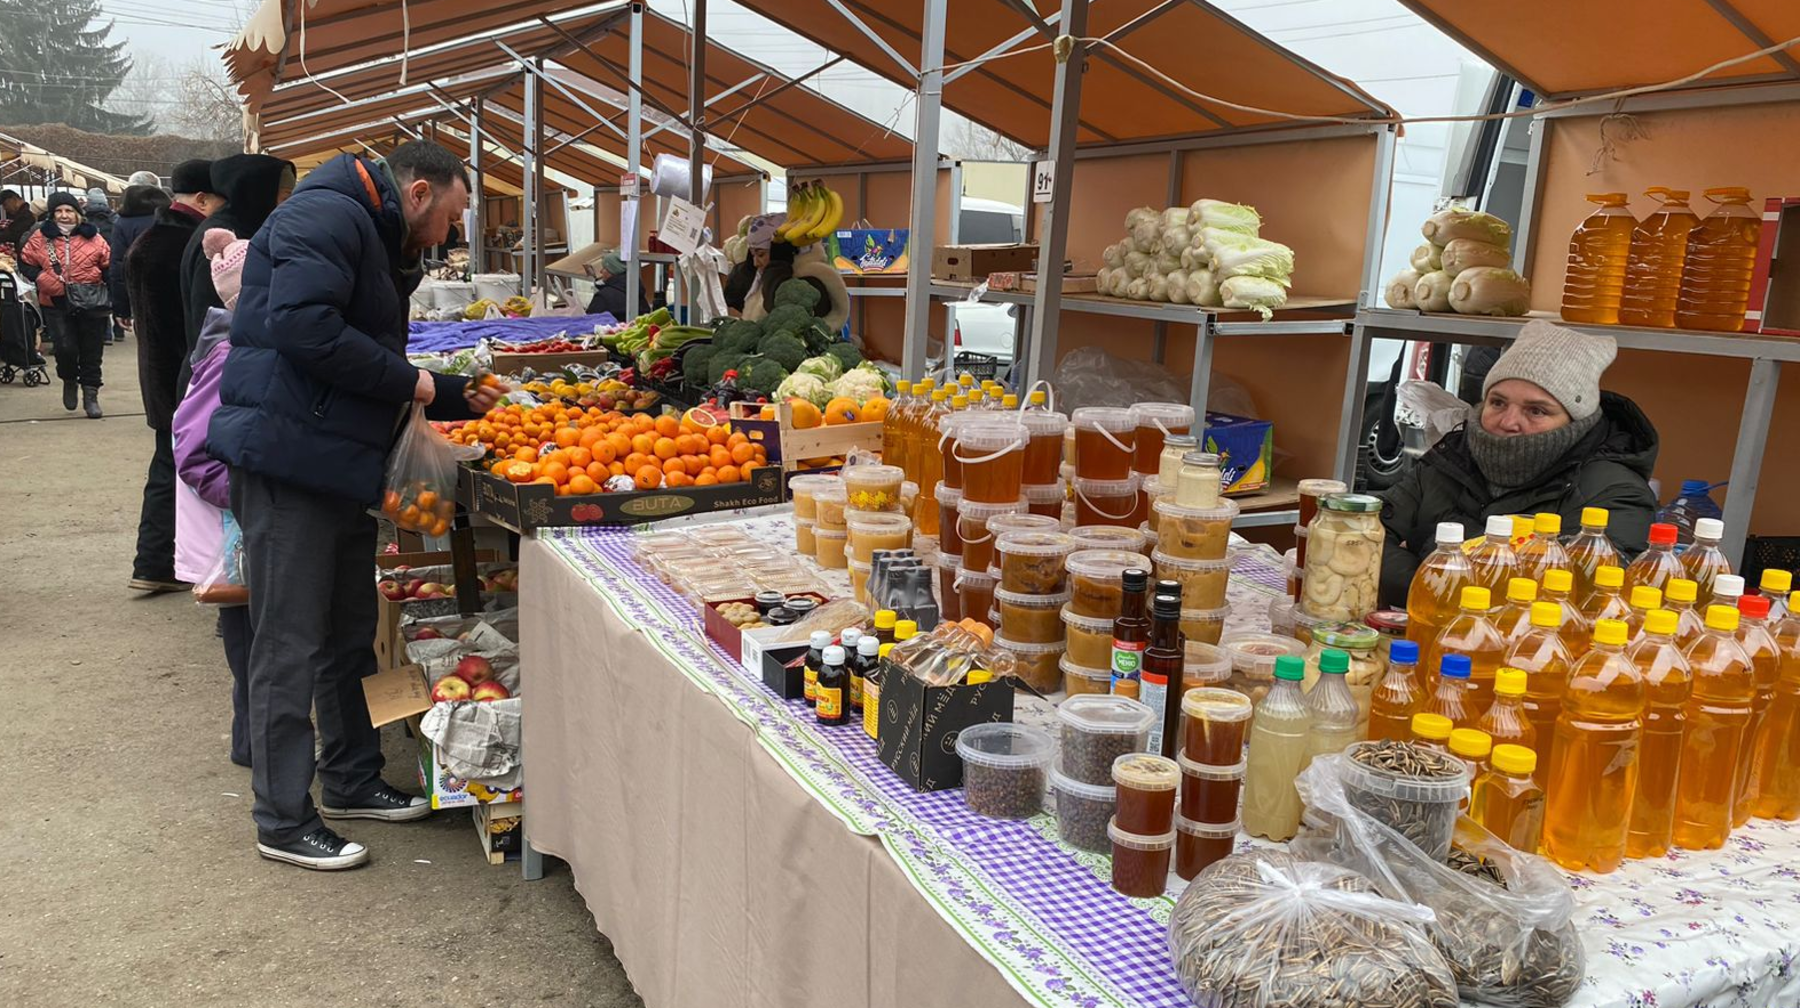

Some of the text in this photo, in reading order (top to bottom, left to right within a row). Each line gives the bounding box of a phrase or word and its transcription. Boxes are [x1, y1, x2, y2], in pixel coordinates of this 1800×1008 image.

[633, 497, 682, 511] BUTA
[714, 496, 779, 508] Shakh Eco Food
[934, 686, 957, 713] МЁД
[891, 702, 919, 771] РУССКИЙ МЁД
